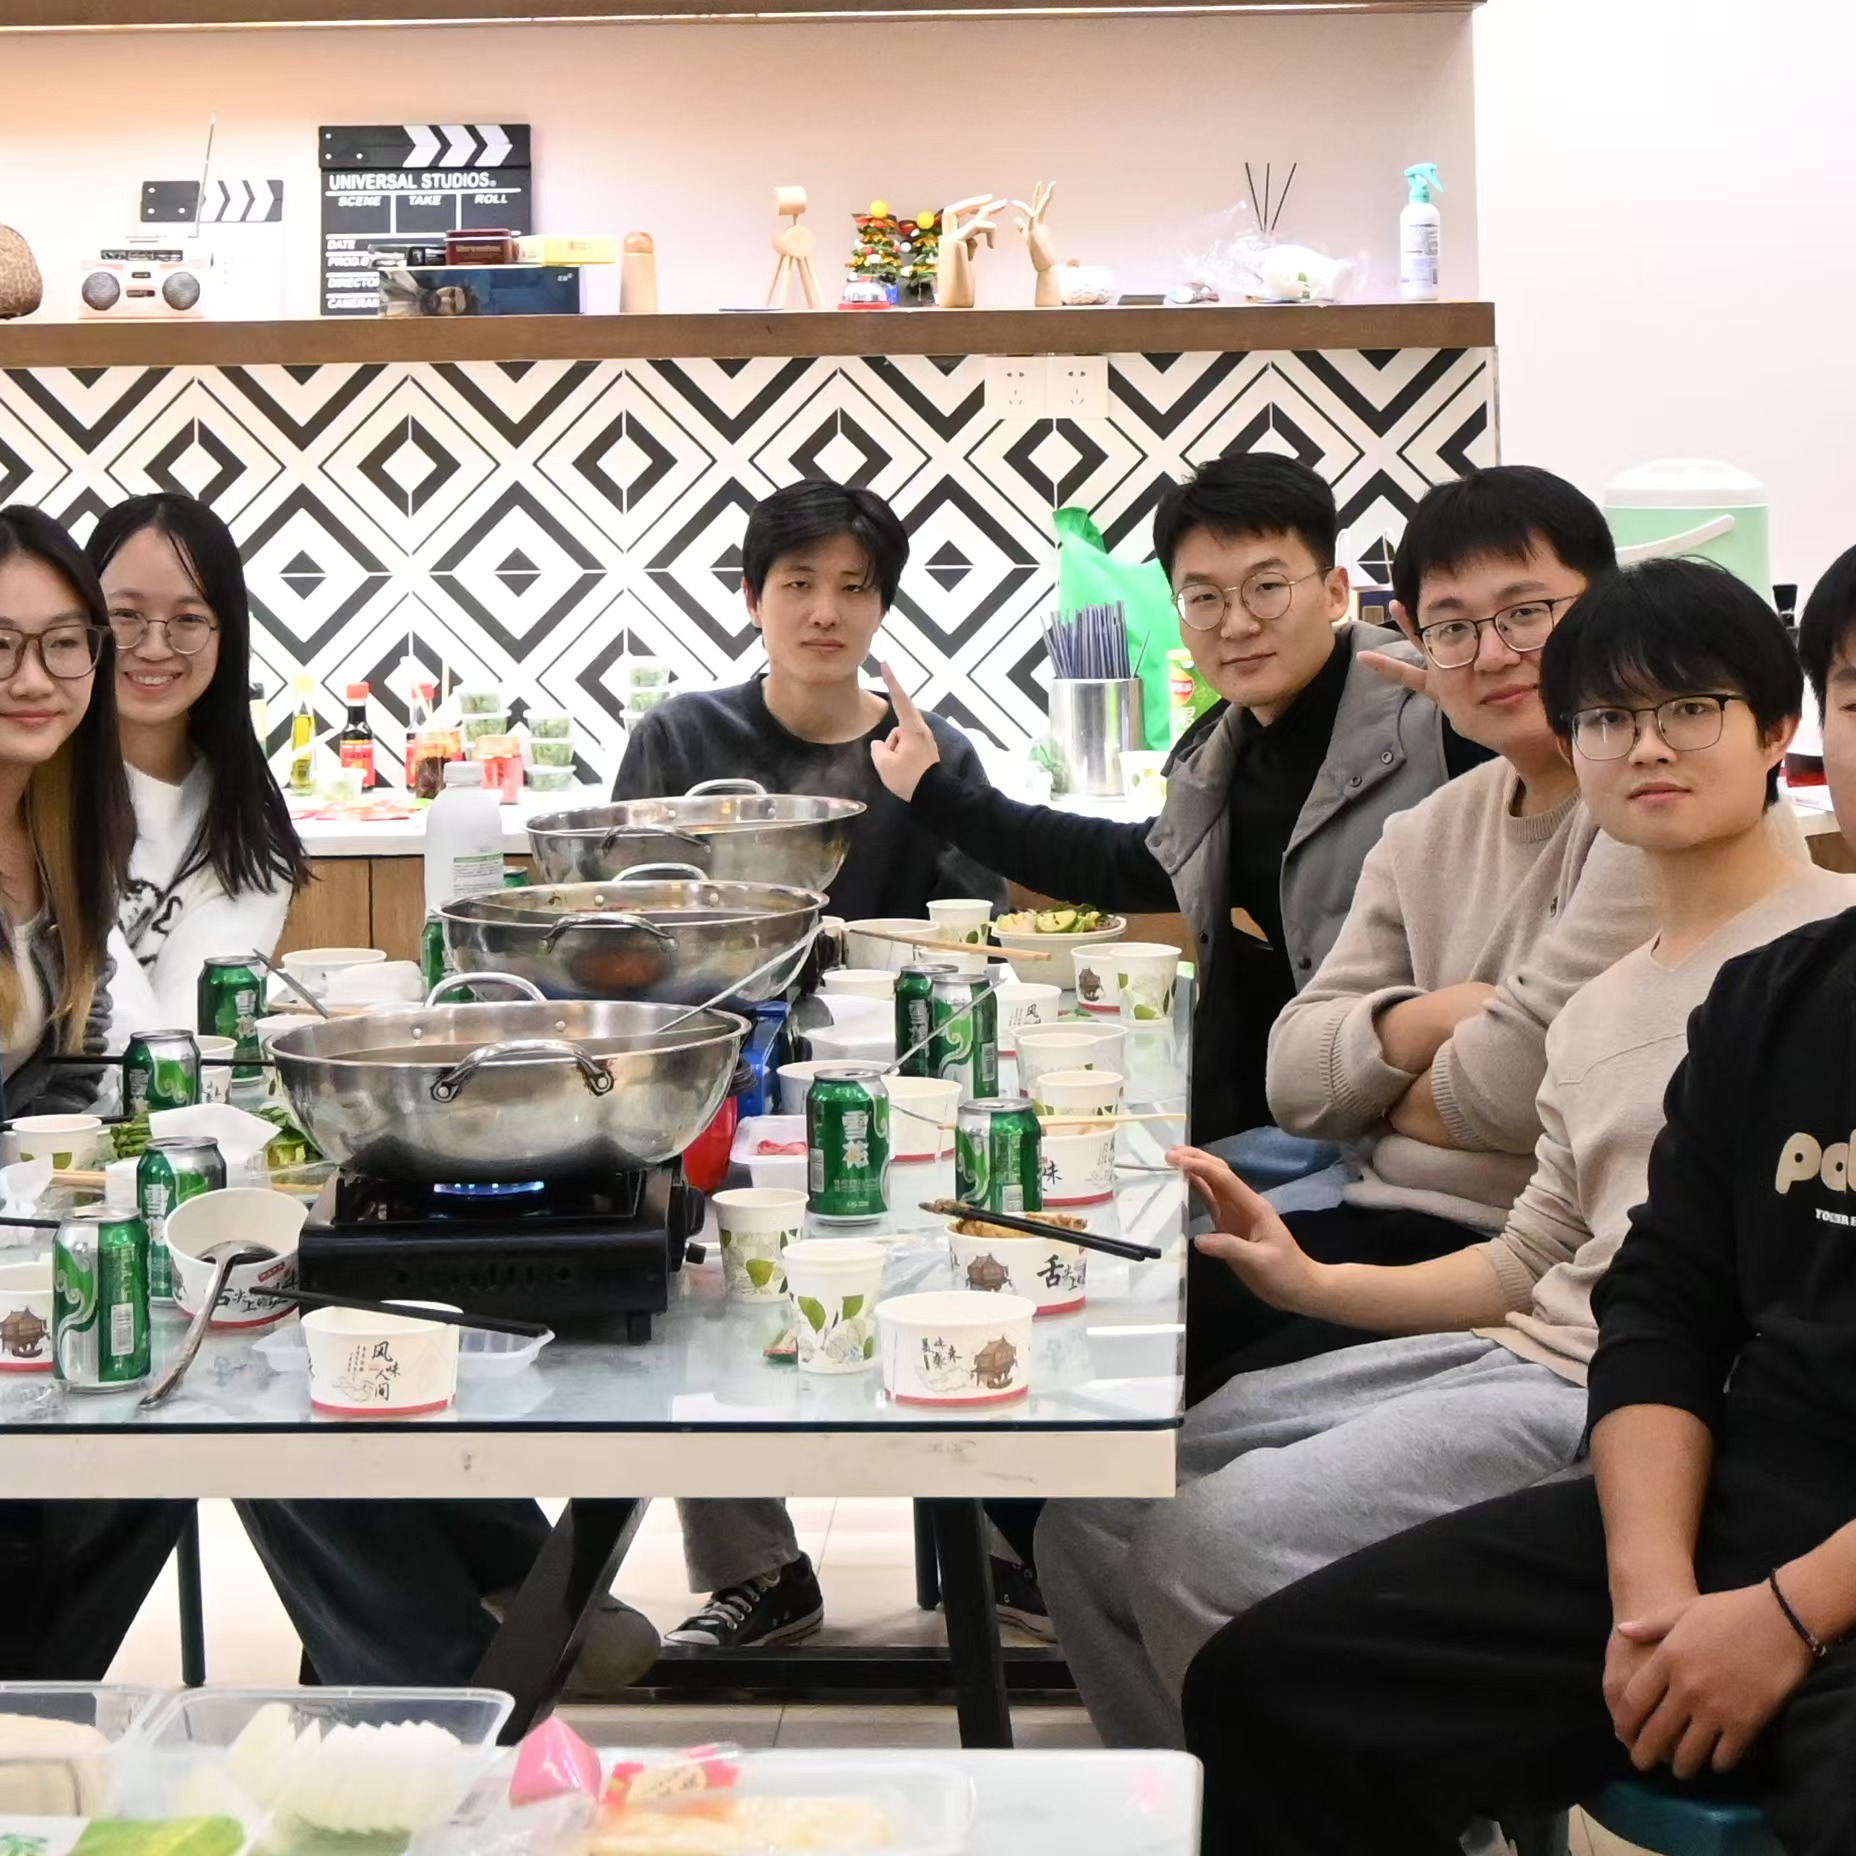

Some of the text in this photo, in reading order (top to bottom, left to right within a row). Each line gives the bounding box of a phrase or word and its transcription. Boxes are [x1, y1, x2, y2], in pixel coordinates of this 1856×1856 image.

[329, 174, 417, 190] UNIVERSAL
[409, 195, 442, 206] TAKE
[474, 194, 508, 204] ROLL
[327, 239, 356, 250] DATE
